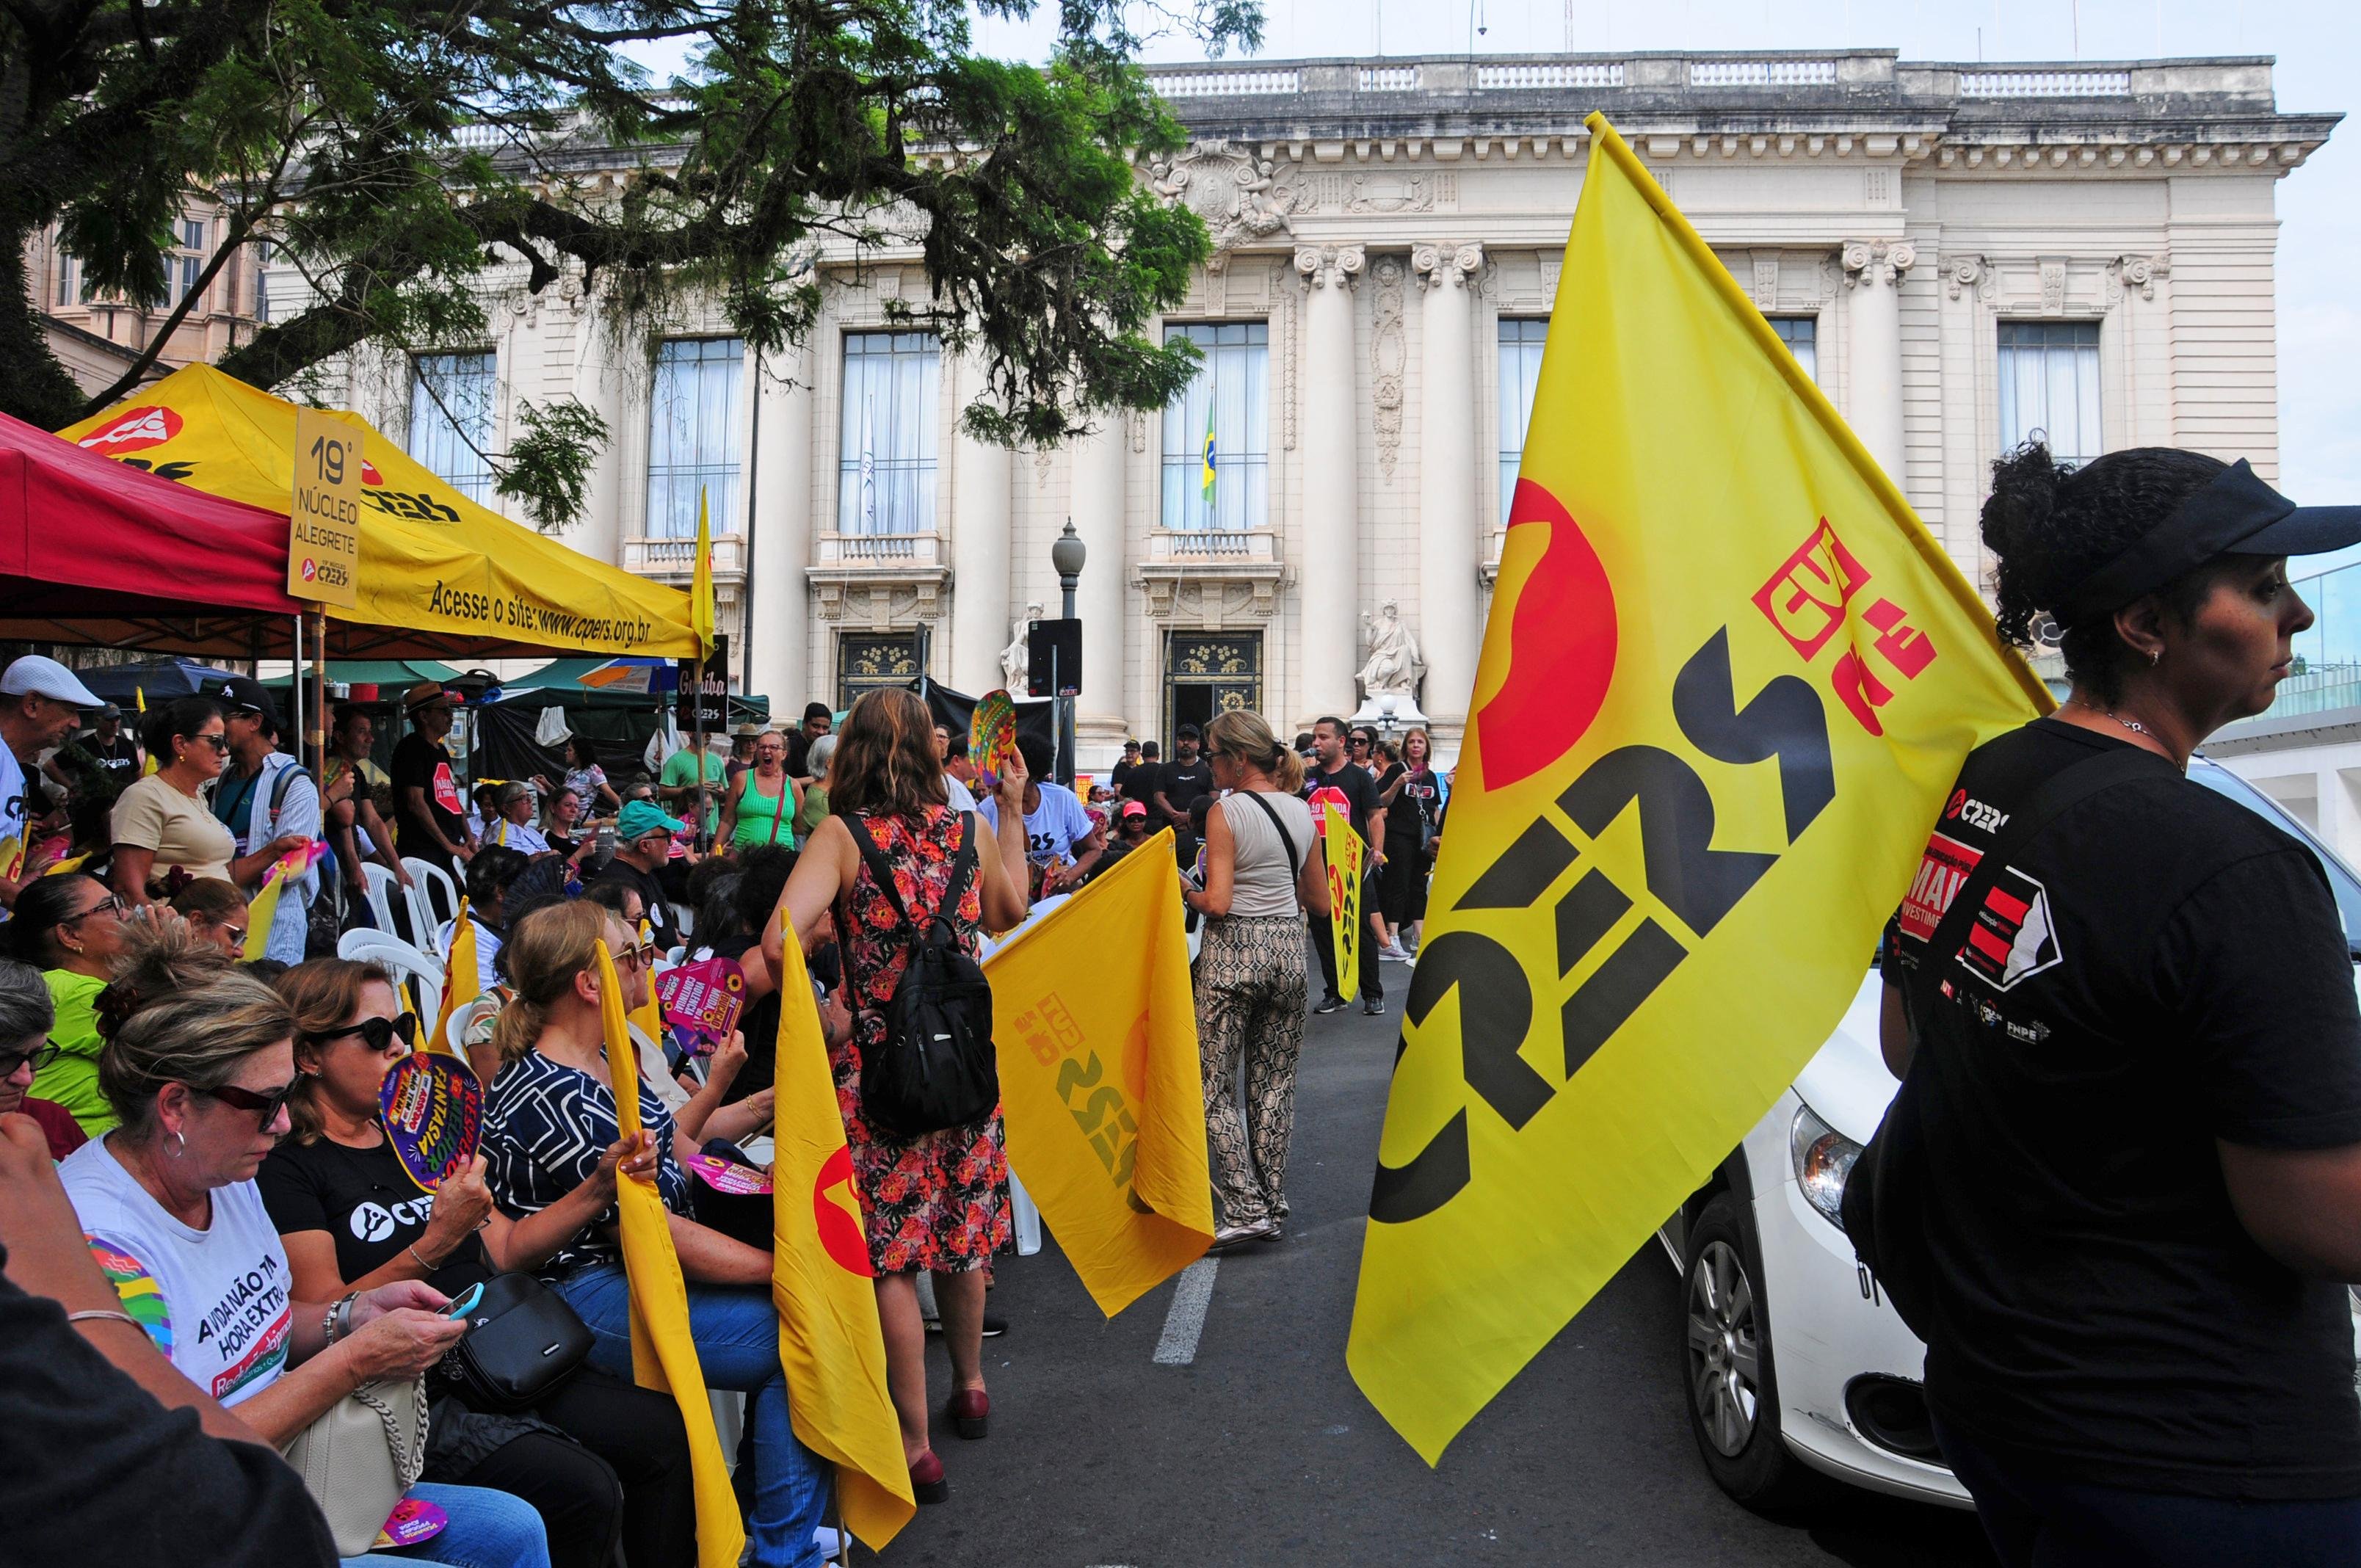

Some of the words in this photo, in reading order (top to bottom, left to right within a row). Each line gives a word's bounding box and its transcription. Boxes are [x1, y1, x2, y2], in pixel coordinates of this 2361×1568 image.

[299, 485, 358, 526] NÚCLEO
[295, 523, 355, 554] ALEGRETE
[318, 565, 348, 587] CPERS
[428, 580, 489, 621] Acesse
[493, 598, 504, 623] o
[1752, 516, 1871, 661] CUT
[1368, 623, 1837, 1224] CPERS
[418, 1066, 447, 1156] FANTASIA
[427, 1098, 463, 1172] MELHOR
[198, 1318, 214, 1344] A
[208, 1300, 232, 1333] VIDA
[225, 1276, 264, 1312] NÃO
[218, 1320, 256, 1362] HORA
